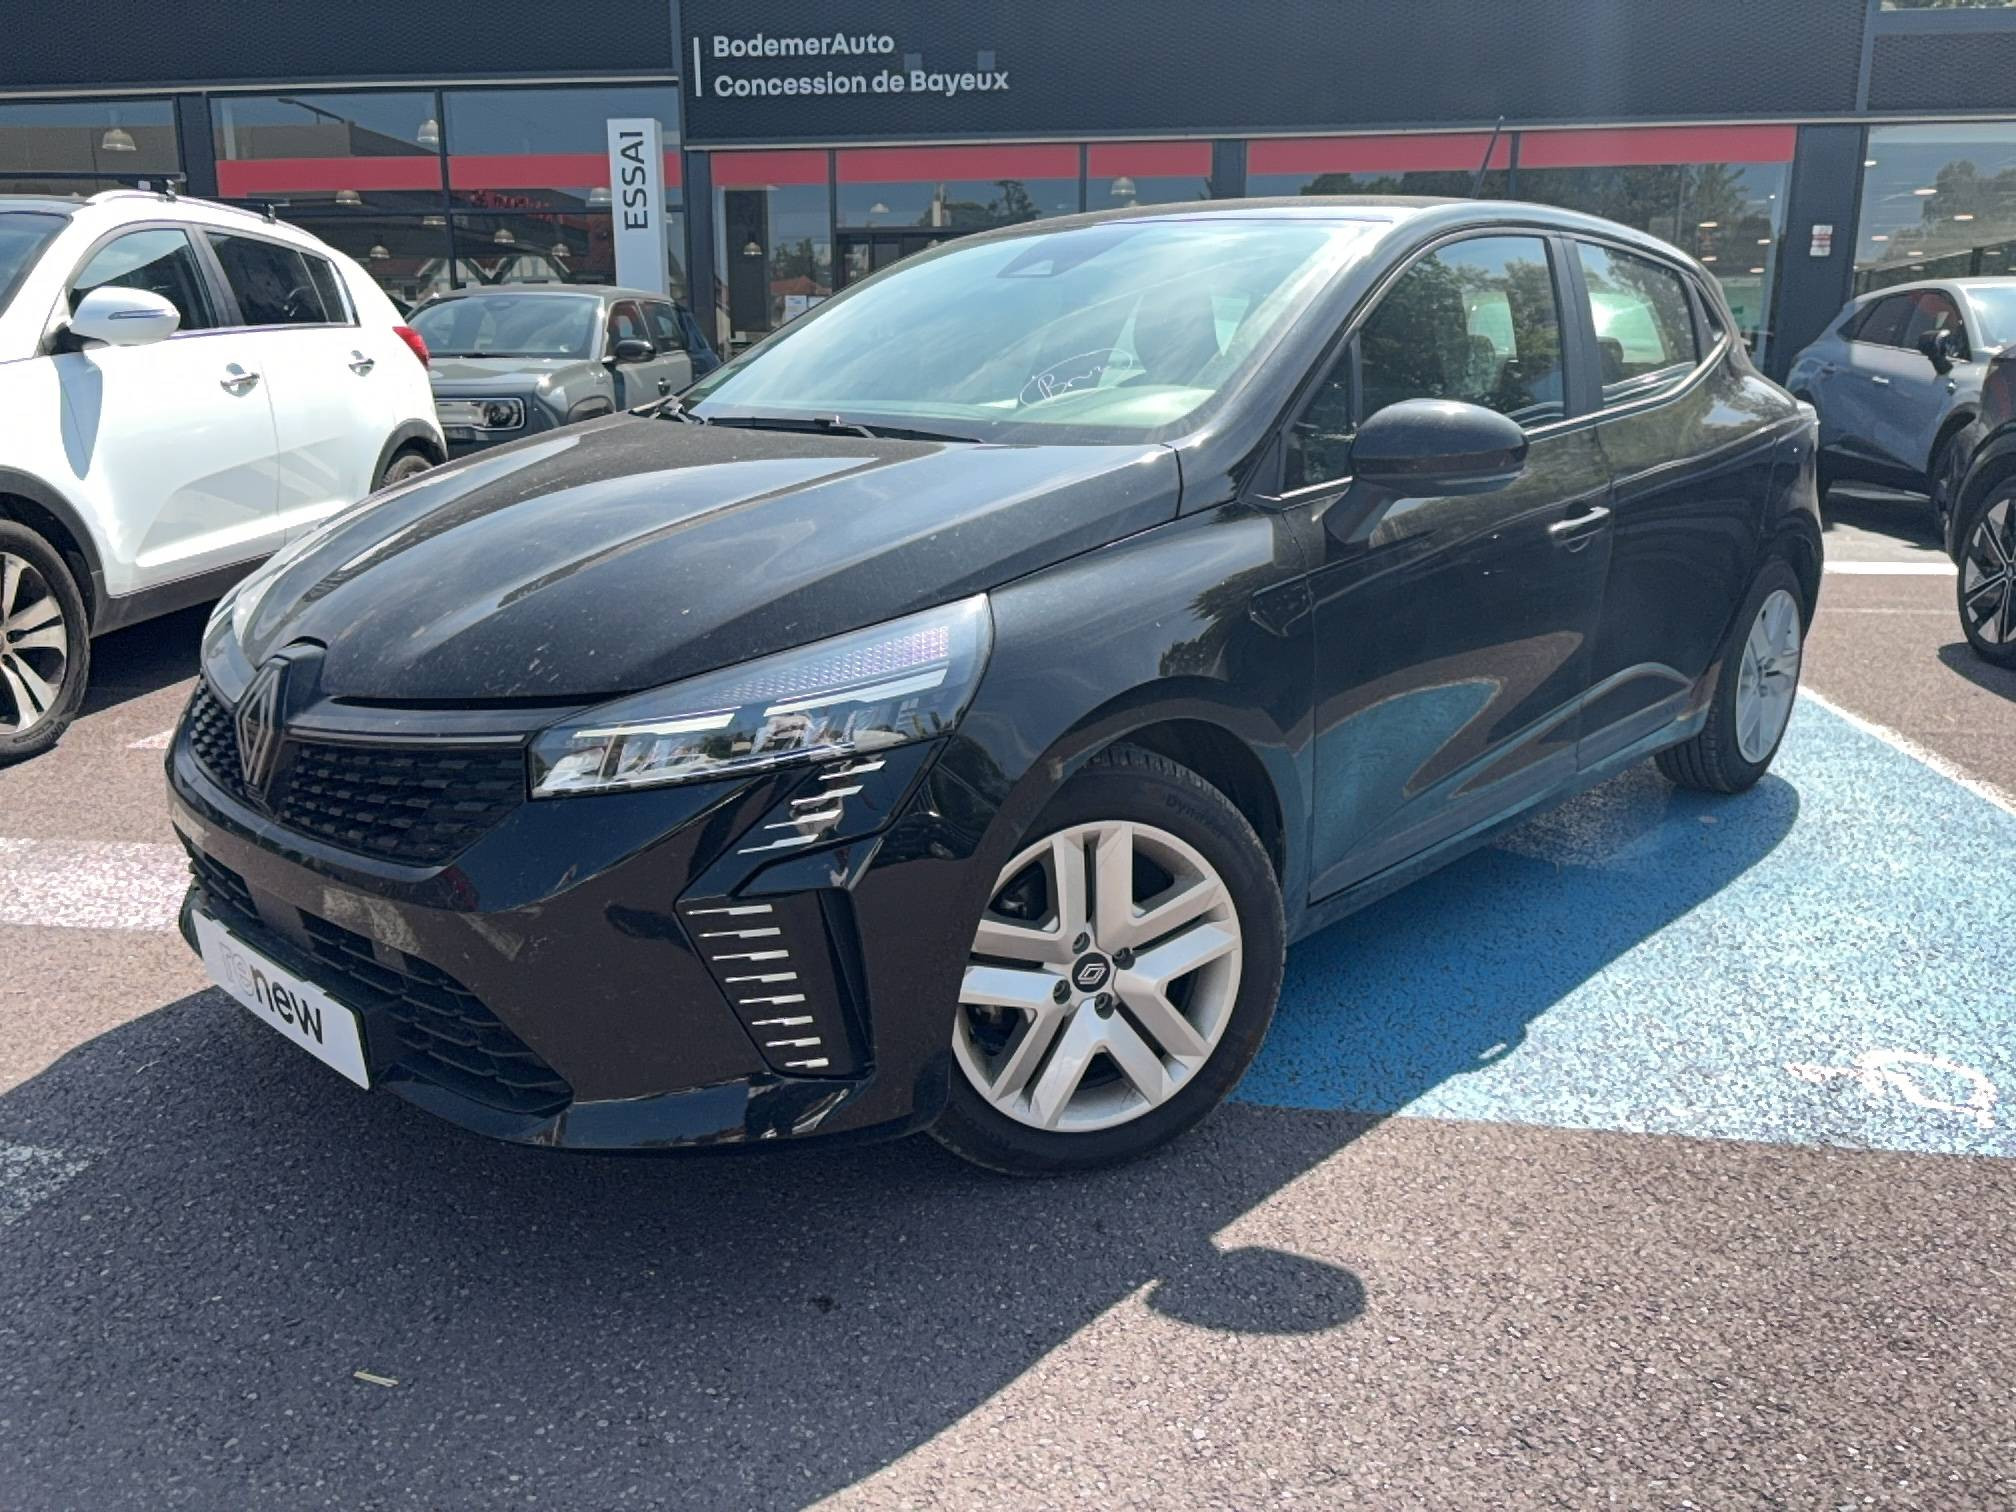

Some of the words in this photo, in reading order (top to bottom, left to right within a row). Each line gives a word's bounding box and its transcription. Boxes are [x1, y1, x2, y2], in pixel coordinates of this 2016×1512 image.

[713, 33, 895, 57] BodemerAuto
[714, 71, 867, 97] Concession
[871, 70, 905, 93] de
[910, 70, 1009, 96] Bayeux
[619, 131, 649, 231] ESSAI
